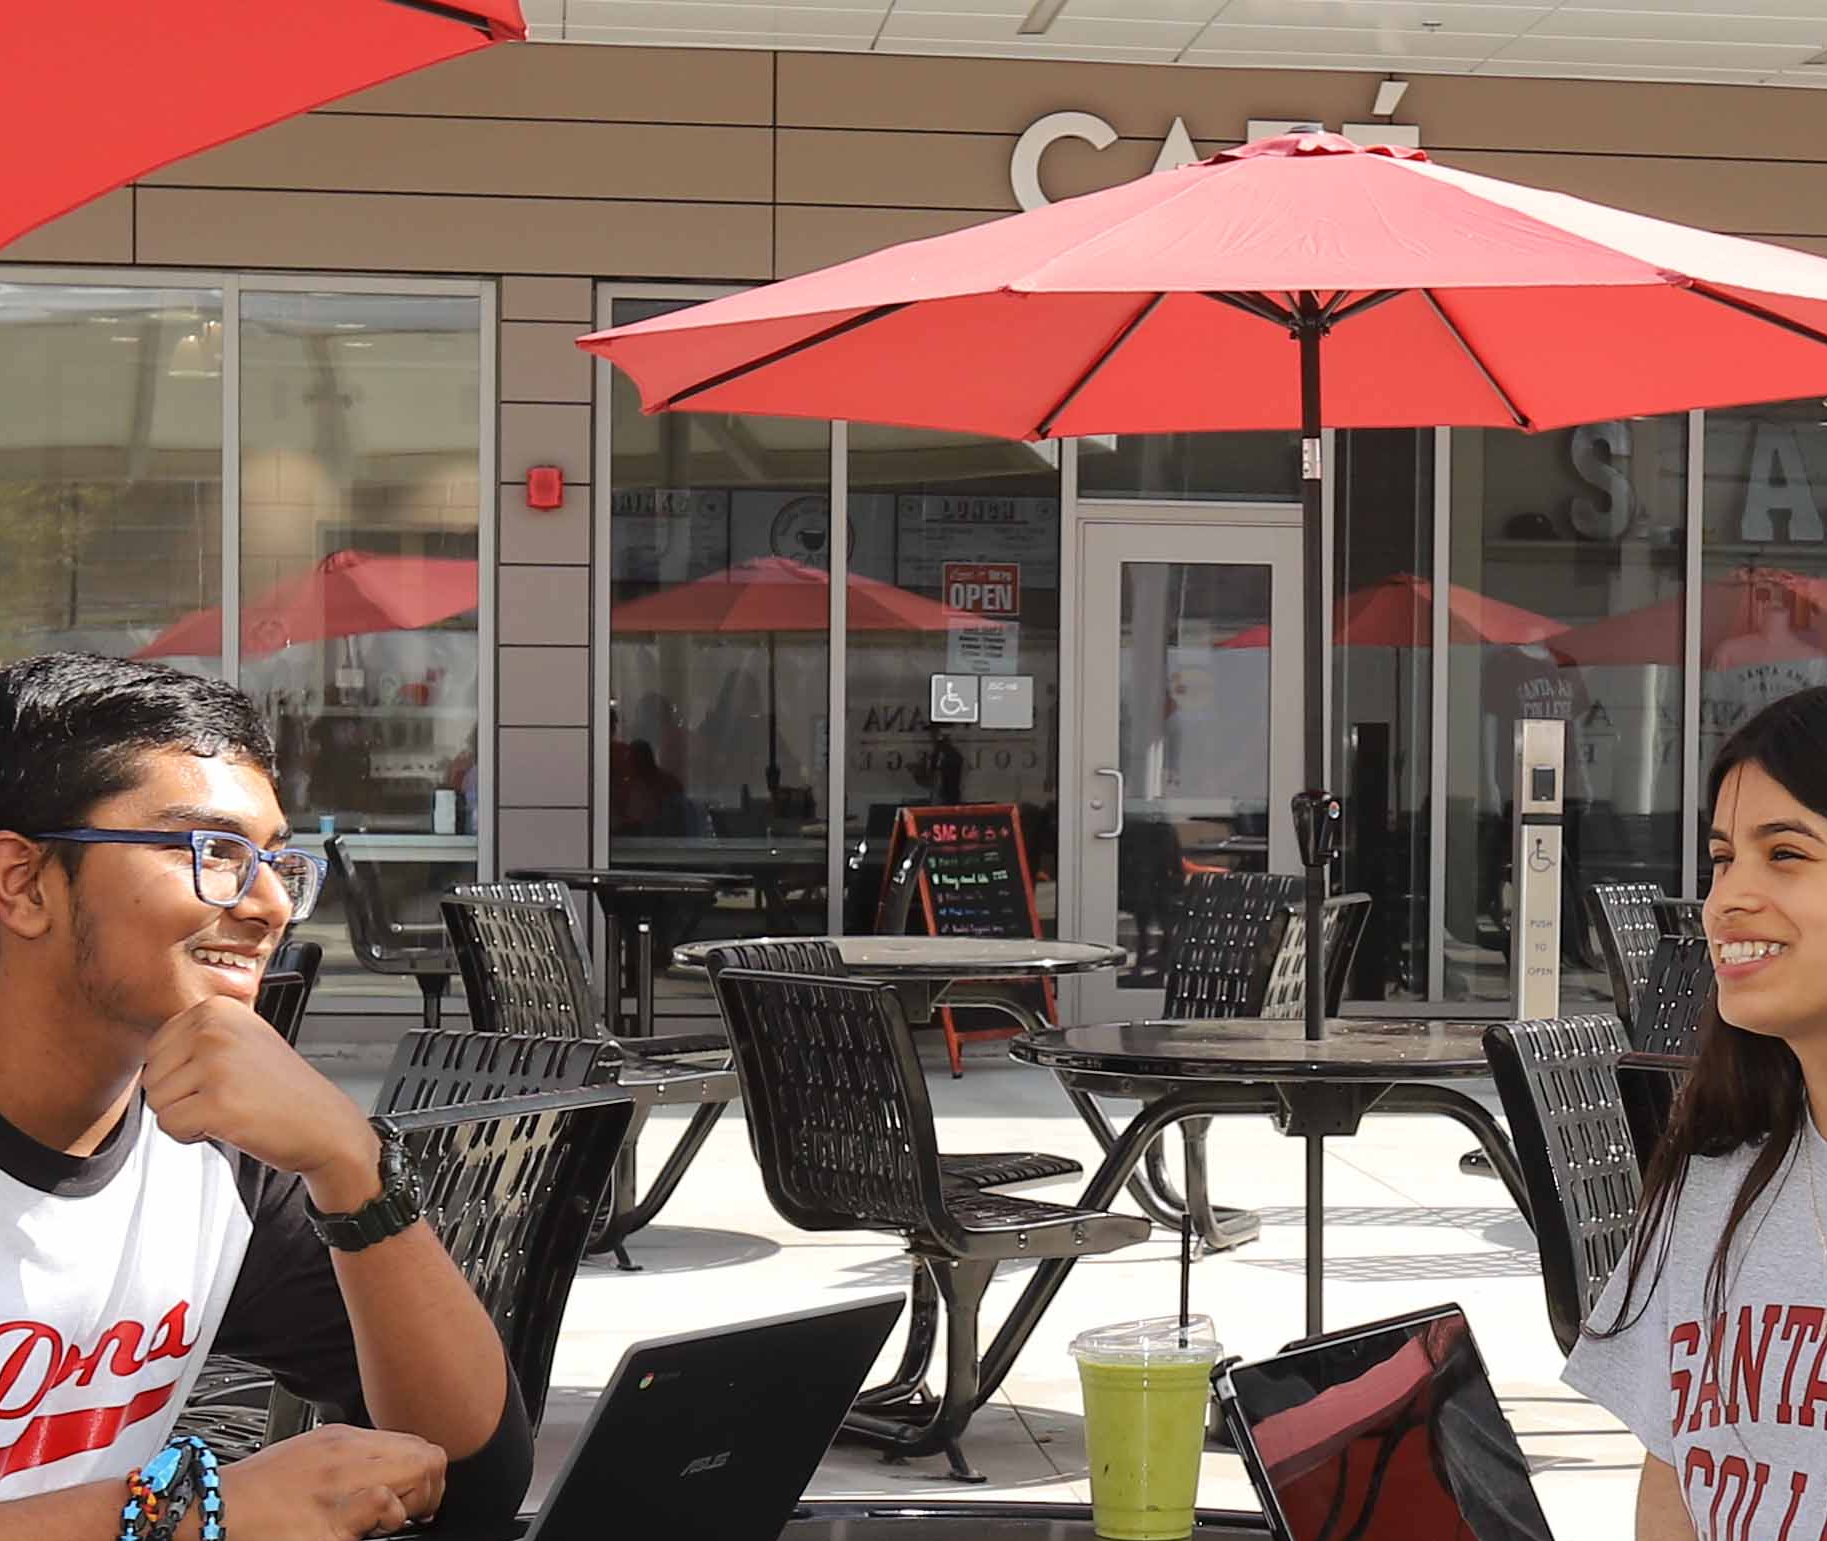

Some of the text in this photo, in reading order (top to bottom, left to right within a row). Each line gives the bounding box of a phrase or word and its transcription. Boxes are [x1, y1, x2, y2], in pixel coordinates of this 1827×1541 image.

[950, 583, 1013, 610] OPEN
[1529, 919, 1553, 928] PUSH
[1535, 943, 1548, 953] TO
[1527, 967, 1553, 977] OPEN
[679, 1450, 732, 1478] ASUS
